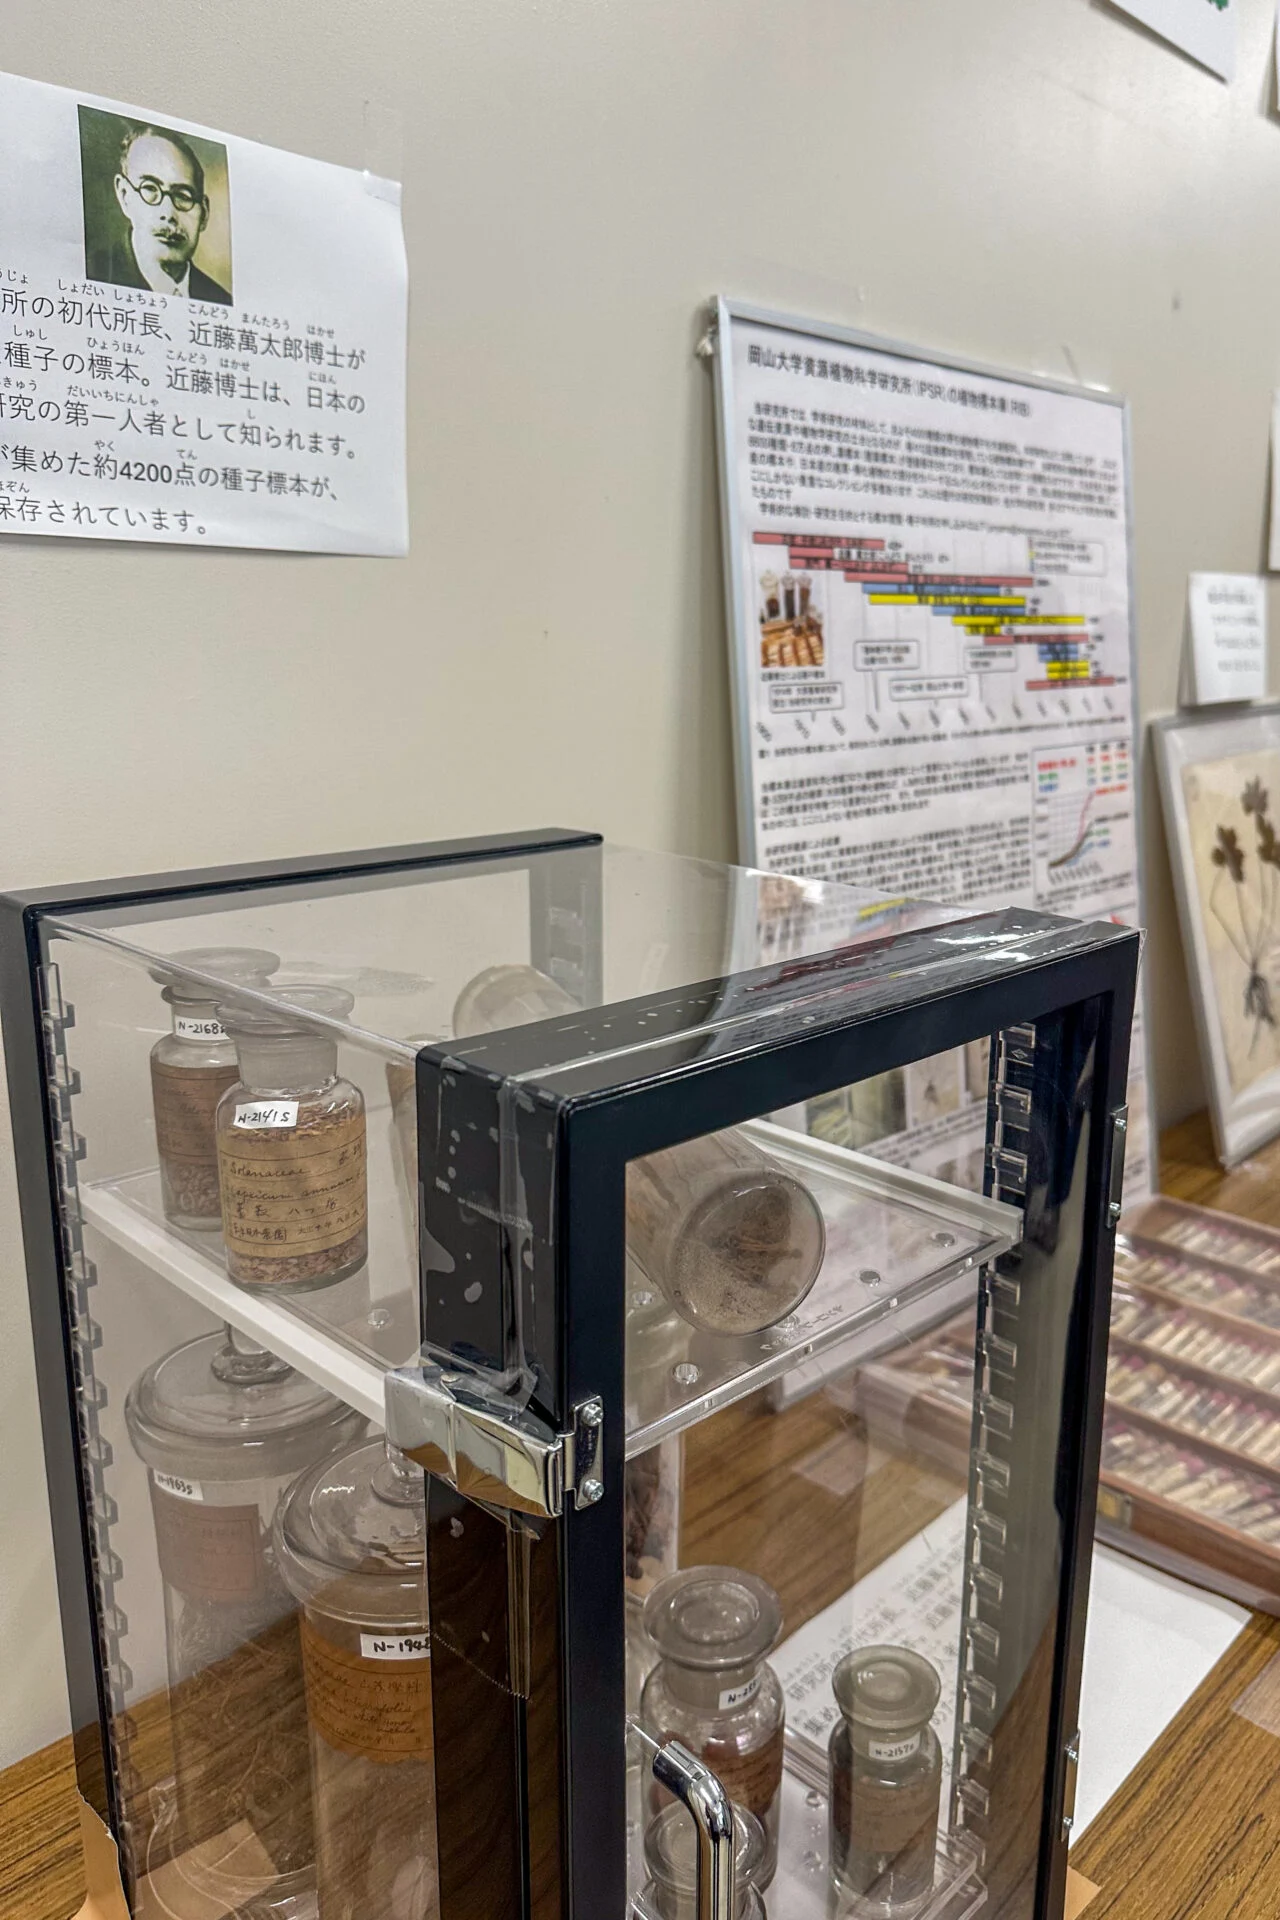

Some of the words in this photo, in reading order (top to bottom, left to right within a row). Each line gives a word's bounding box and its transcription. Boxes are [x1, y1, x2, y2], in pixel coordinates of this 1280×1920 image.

[58, 279, 105, 296] しょだい
[114, 290, 168, 309] しょちょう
[188, 304, 229, 320] こんどう
[241, 313, 290, 331] まんたろう
[307, 324, 335, 338] はかせ
[13, 324, 48, 340] しゅし
[87, 337, 145, 355] ひょうほん
[166, 349, 208, 366] こんどう
[220, 357, 250, 371] はかせ
[0, 341, 366, 414] 種子の標本。近藤博士は、日本の
[0, 376, 37, 391] きゅう
[67, 385, 159, 407] だいいちにんしゃ
[94, 439, 115, 452] やく
[176, 448, 197, 460] てん
